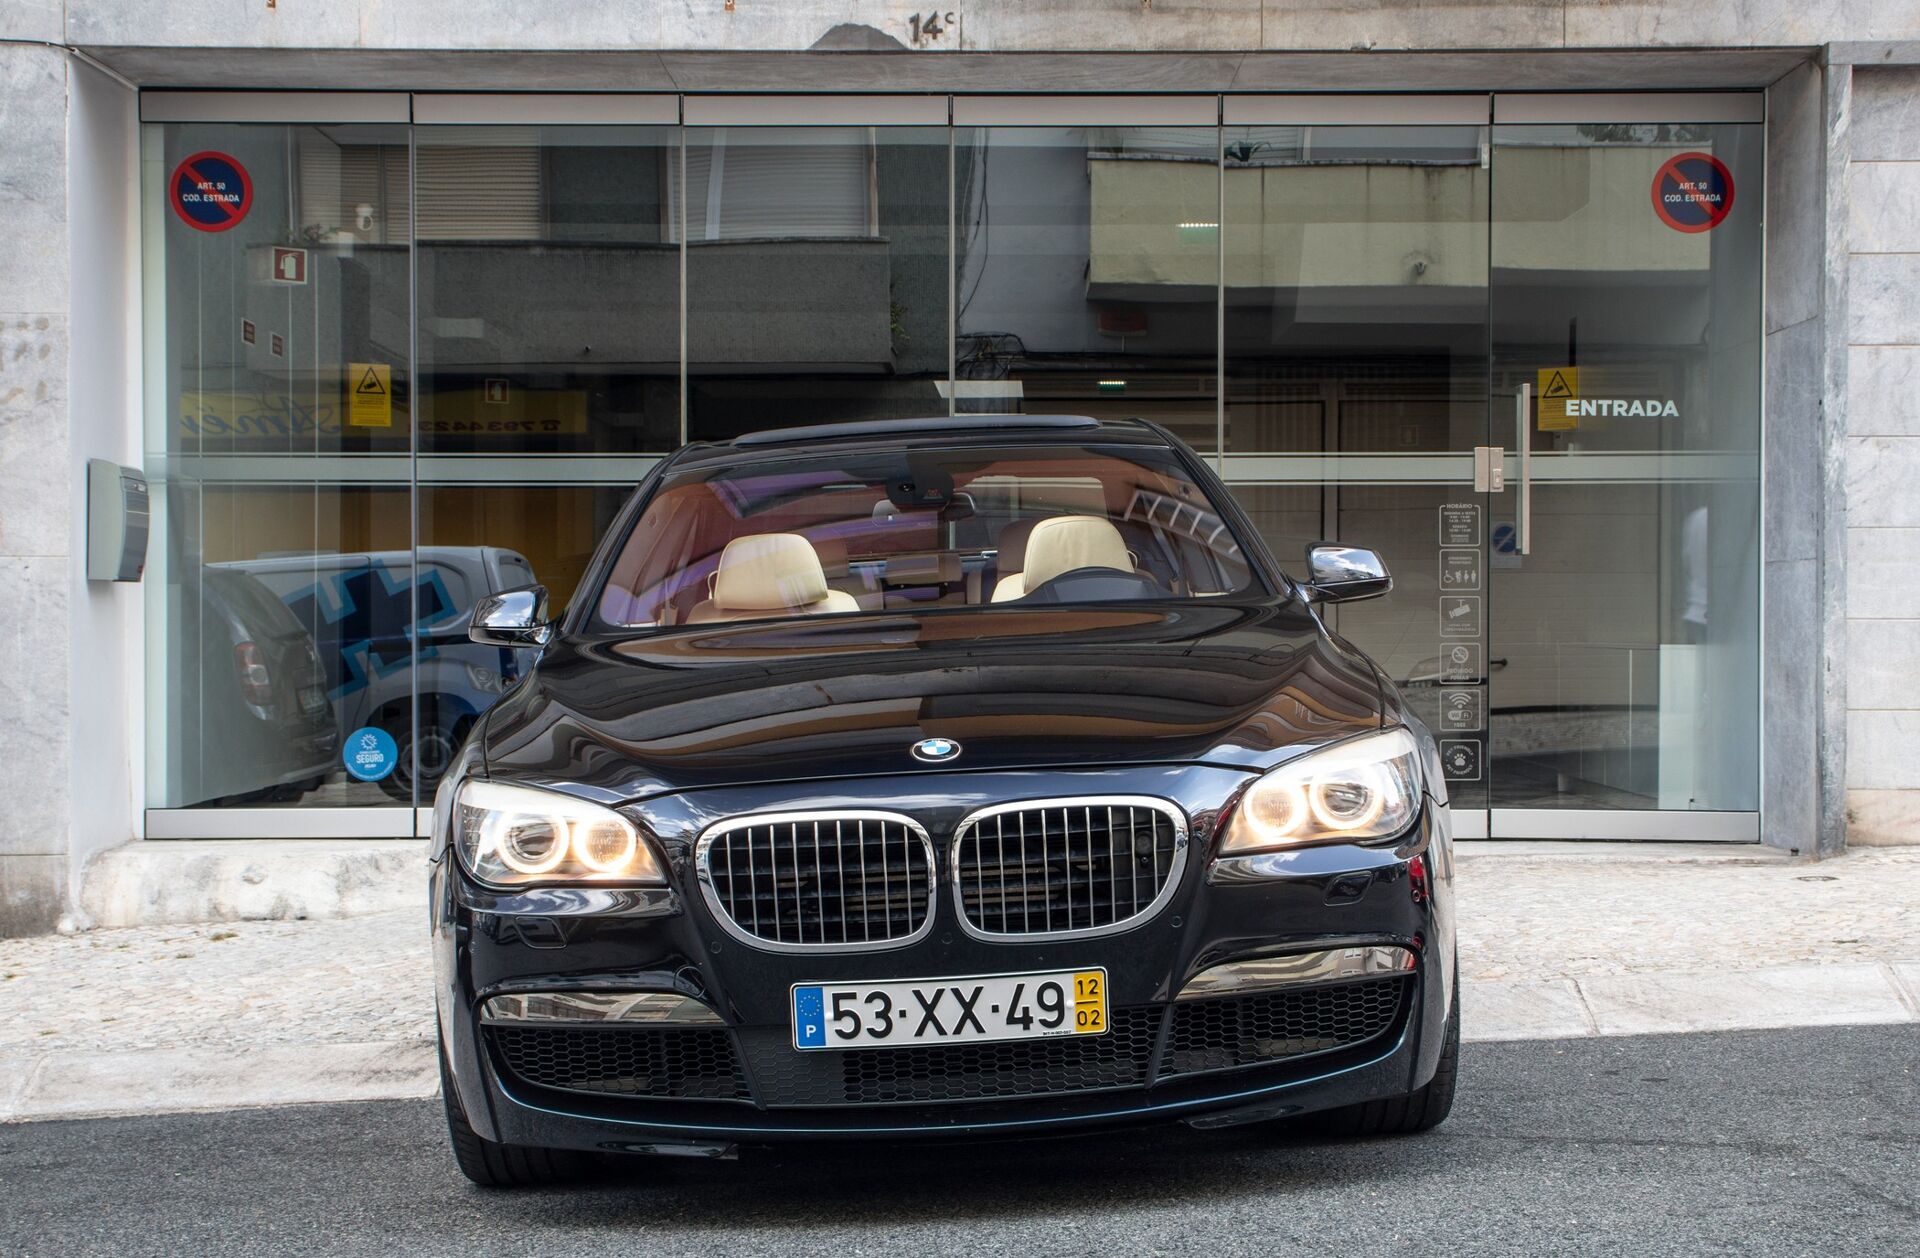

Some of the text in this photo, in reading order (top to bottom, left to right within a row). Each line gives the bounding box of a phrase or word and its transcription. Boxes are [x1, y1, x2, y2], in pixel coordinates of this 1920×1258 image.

[197, 182, 226, 190] ART. 50
[1678, 182, 1707, 190] ART. 50
[182, 194, 240, 202] COD. ESTRADA
[1664, 194, 1721, 202] COD. ESTRADA
[1565, 399, 1680, 417] ENTRADA
[355, 753, 384, 764] SEGURO
[1077, 978, 1099, 996] 12
[1077, 1009, 1101, 1026] 02
[805, 1025, 817, 1038] P
